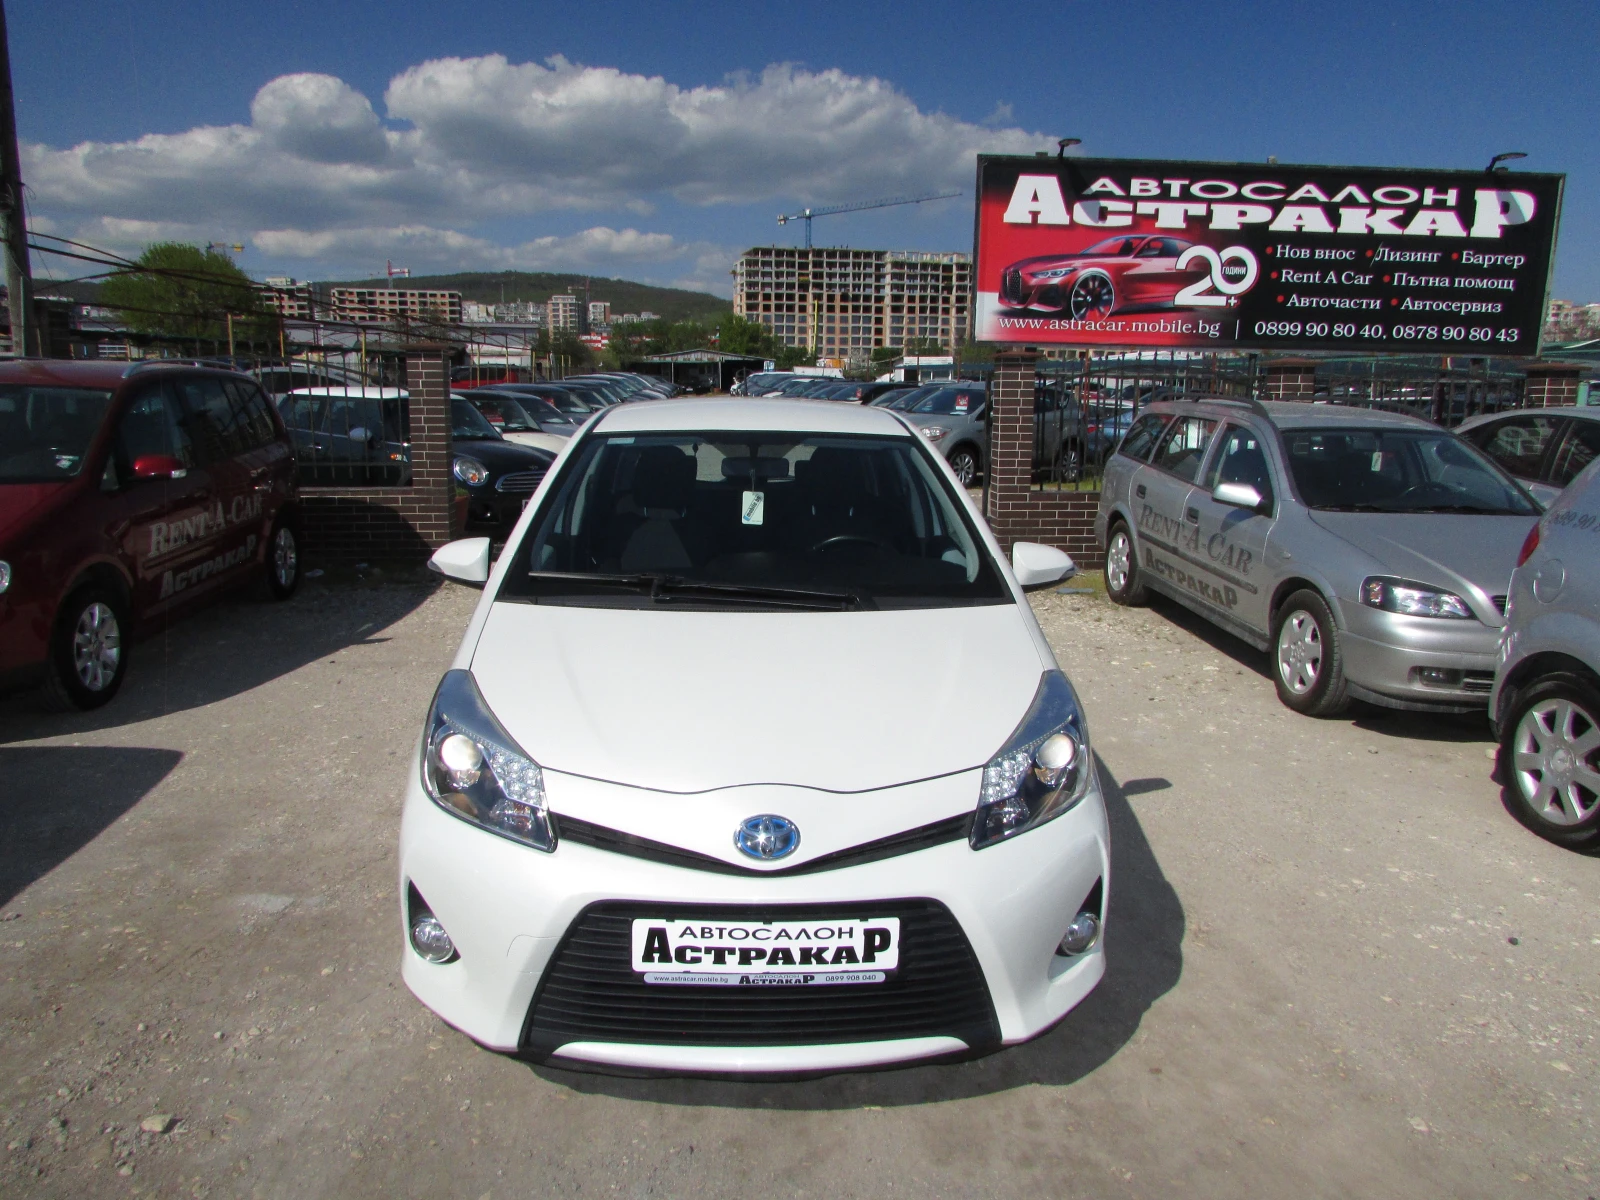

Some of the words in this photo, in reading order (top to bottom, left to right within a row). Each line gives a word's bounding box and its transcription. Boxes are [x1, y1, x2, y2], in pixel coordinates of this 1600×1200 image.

[1081, 177, 1458, 207] АВТОСАЛОН
[1276, 245, 1311, 260] Нов
[1314, 248, 1356, 261] внос
[1375, 248, 1443, 264] Лизинг
[1461, 250, 1526, 269] Бартер
[1221, 265, 1247, 276] ГОДИНИ
[1280, 270, 1321, 284] Rent
[1324, 271, 1338, 285] A
[1341, 271, 1374, 286] Car
[1392, 273, 1450, 288] Пътна
[1453, 277, 1516, 292] помощ
[1286, 294, 1382, 310] Авточасти
[1400, 297, 1503, 315] Автосервиз
[998, 316, 1221, 338] www.astracar.mobile.bg
[1254, 321, 1301, 337] 0899
[1305, 322, 1328, 337] 90
[1332, 323, 1355, 338] 80
[1359, 324, 1388, 340] 40,
[1392, 325, 1439, 340] 0878
[1442, 326, 1465, 341] 90
[1468, 327, 1491, 342] 80
[1495, 328, 1519, 342] 43
[678, 926, 854, 941] АВТОСАЛОН
[653, 974, 729, 984] www.astracar.mobile.bg
[825, 974, 842, 983] 0899
[843, 974, 861, 982] 908
[862, 974, 877, 982] 040
